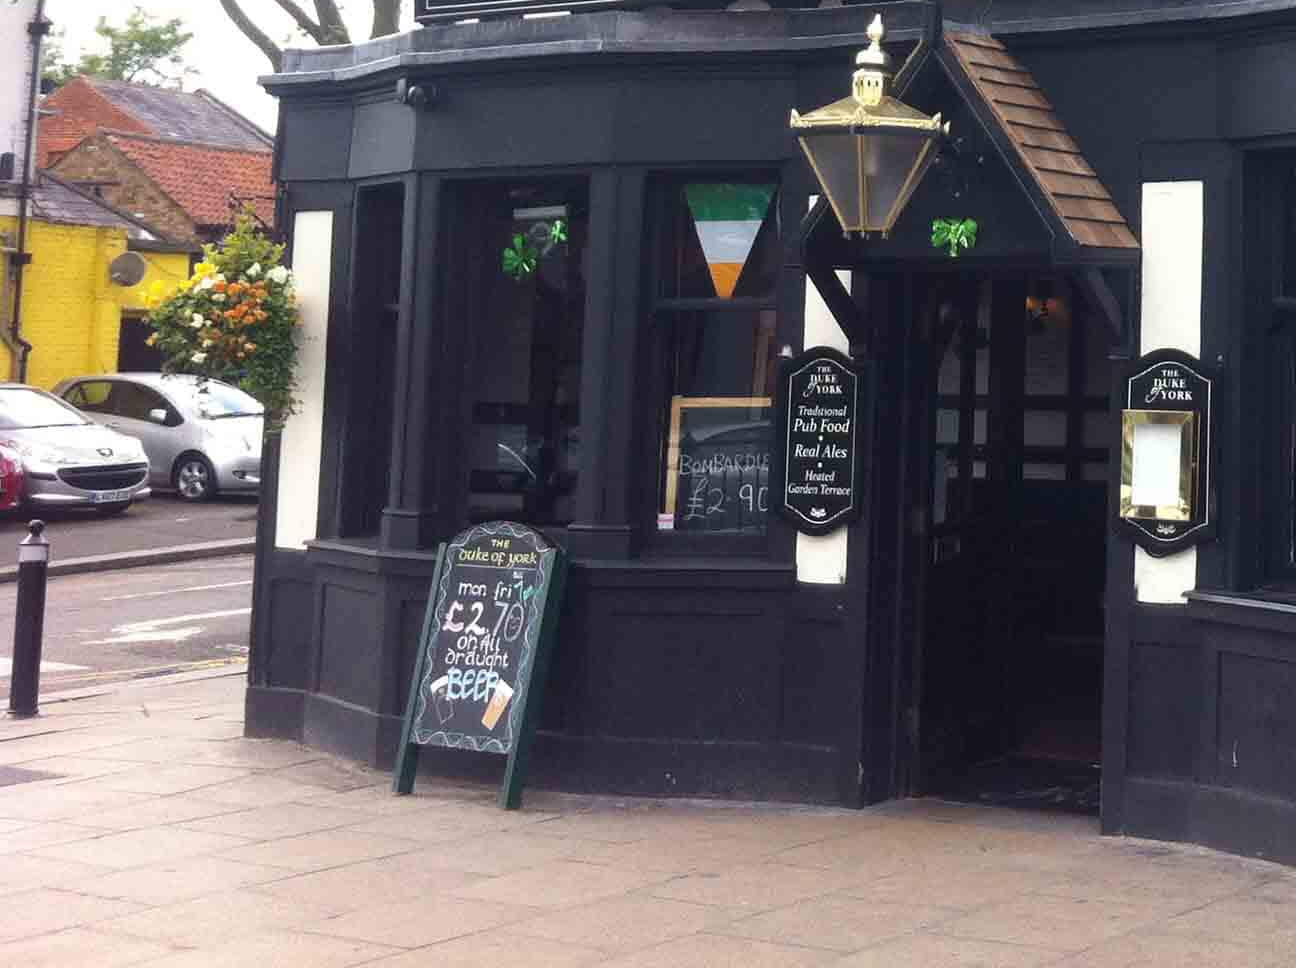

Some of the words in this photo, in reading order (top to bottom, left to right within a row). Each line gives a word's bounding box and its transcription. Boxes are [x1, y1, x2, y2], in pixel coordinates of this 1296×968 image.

[810, 374, 838, 383] DUKE
[1161, 369, 1179, 377] THE
[1153, 378, 1186, 388] DUKE
[815, 385, 842, 394] YORK
[1161, 390, 1193, 401] YORK
[798, 405, 847, 417] Traditional
[792, 418, 817, 432] Pub
[820, 418, 850, 432] Food
[794, 443, 820, 457] Real
[821, 443, 848, 459] Ales
[805, 470, 835, 481] Heated
[789, 483, 818, 495] Garden
[820, 484, 851, 496] Terrace
[490, 538, 511, 549] THE
[458, 582, 487, 597] mon
[494, 581, 512, 601] fri
[457, 635, 478, 650] on
